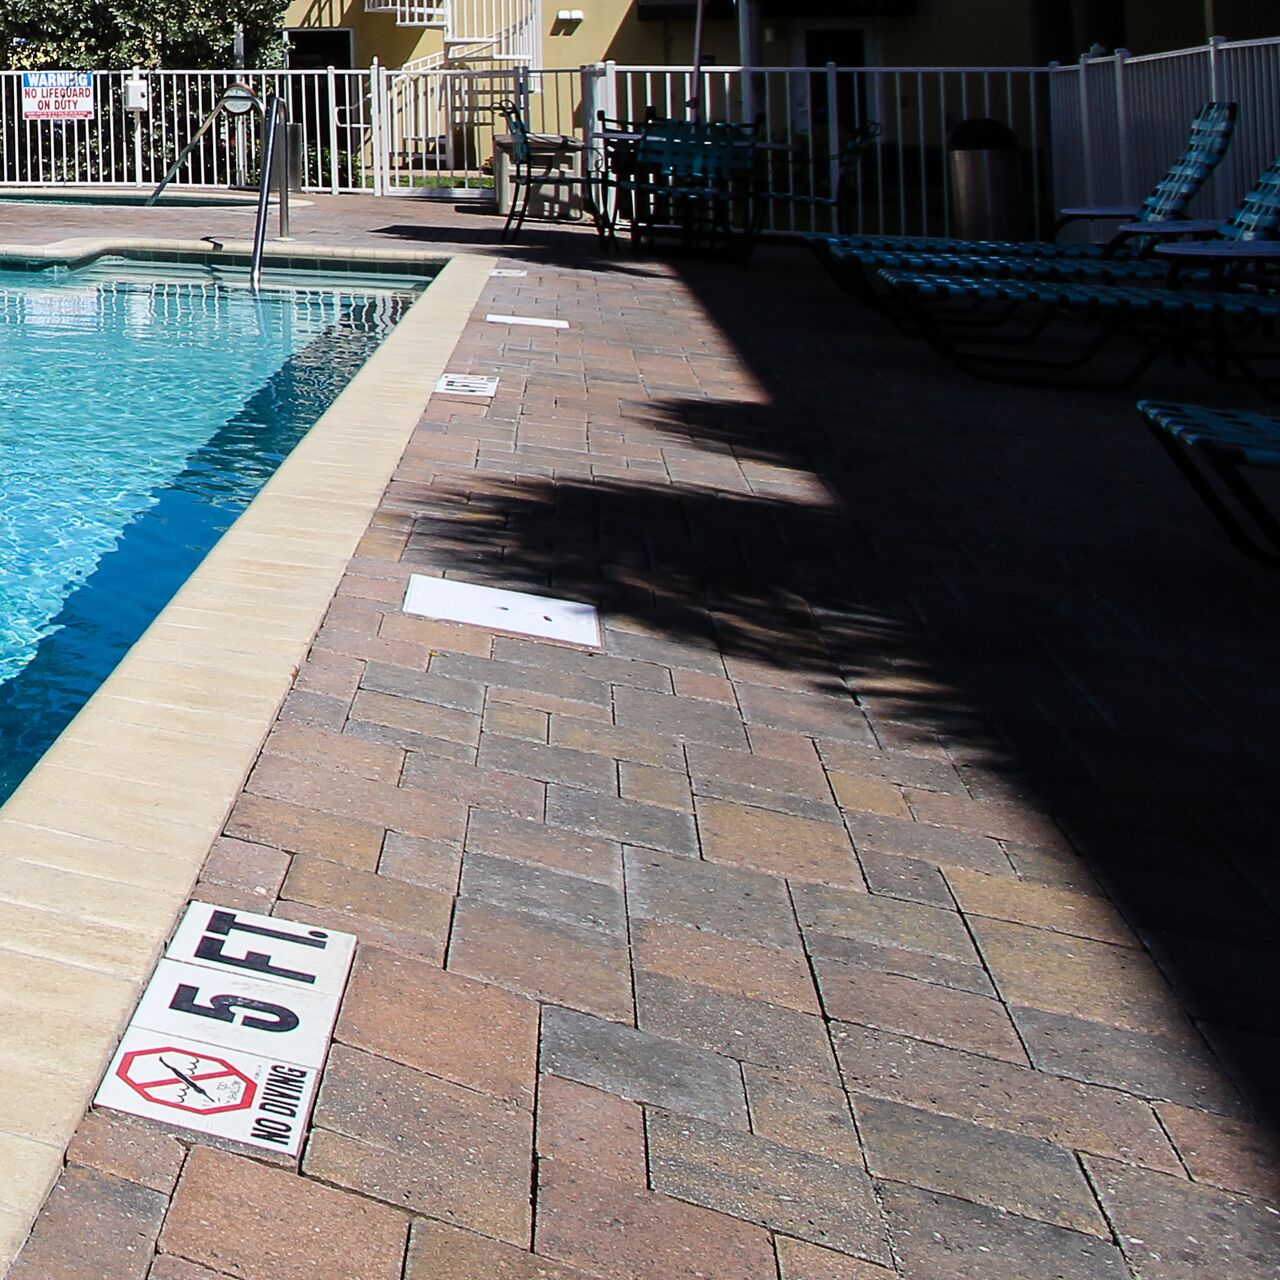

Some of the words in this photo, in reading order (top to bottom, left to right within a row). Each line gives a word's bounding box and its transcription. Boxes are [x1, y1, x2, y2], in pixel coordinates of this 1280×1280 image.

[24, 88, 37, 99] NO
[41, 88, 91, 99] LIFEGUARD
[27, 73, 88, 87] WARNING
[37, 100, 50, 110] ON
[54, 100, 78, 110] DUTY
[194, 910, 329, 984] FT.
[168, 983, 300, 1033] 5
[259, 1065, 308, 1118] DIVING
[250, 1116, 293, 1146] NO
